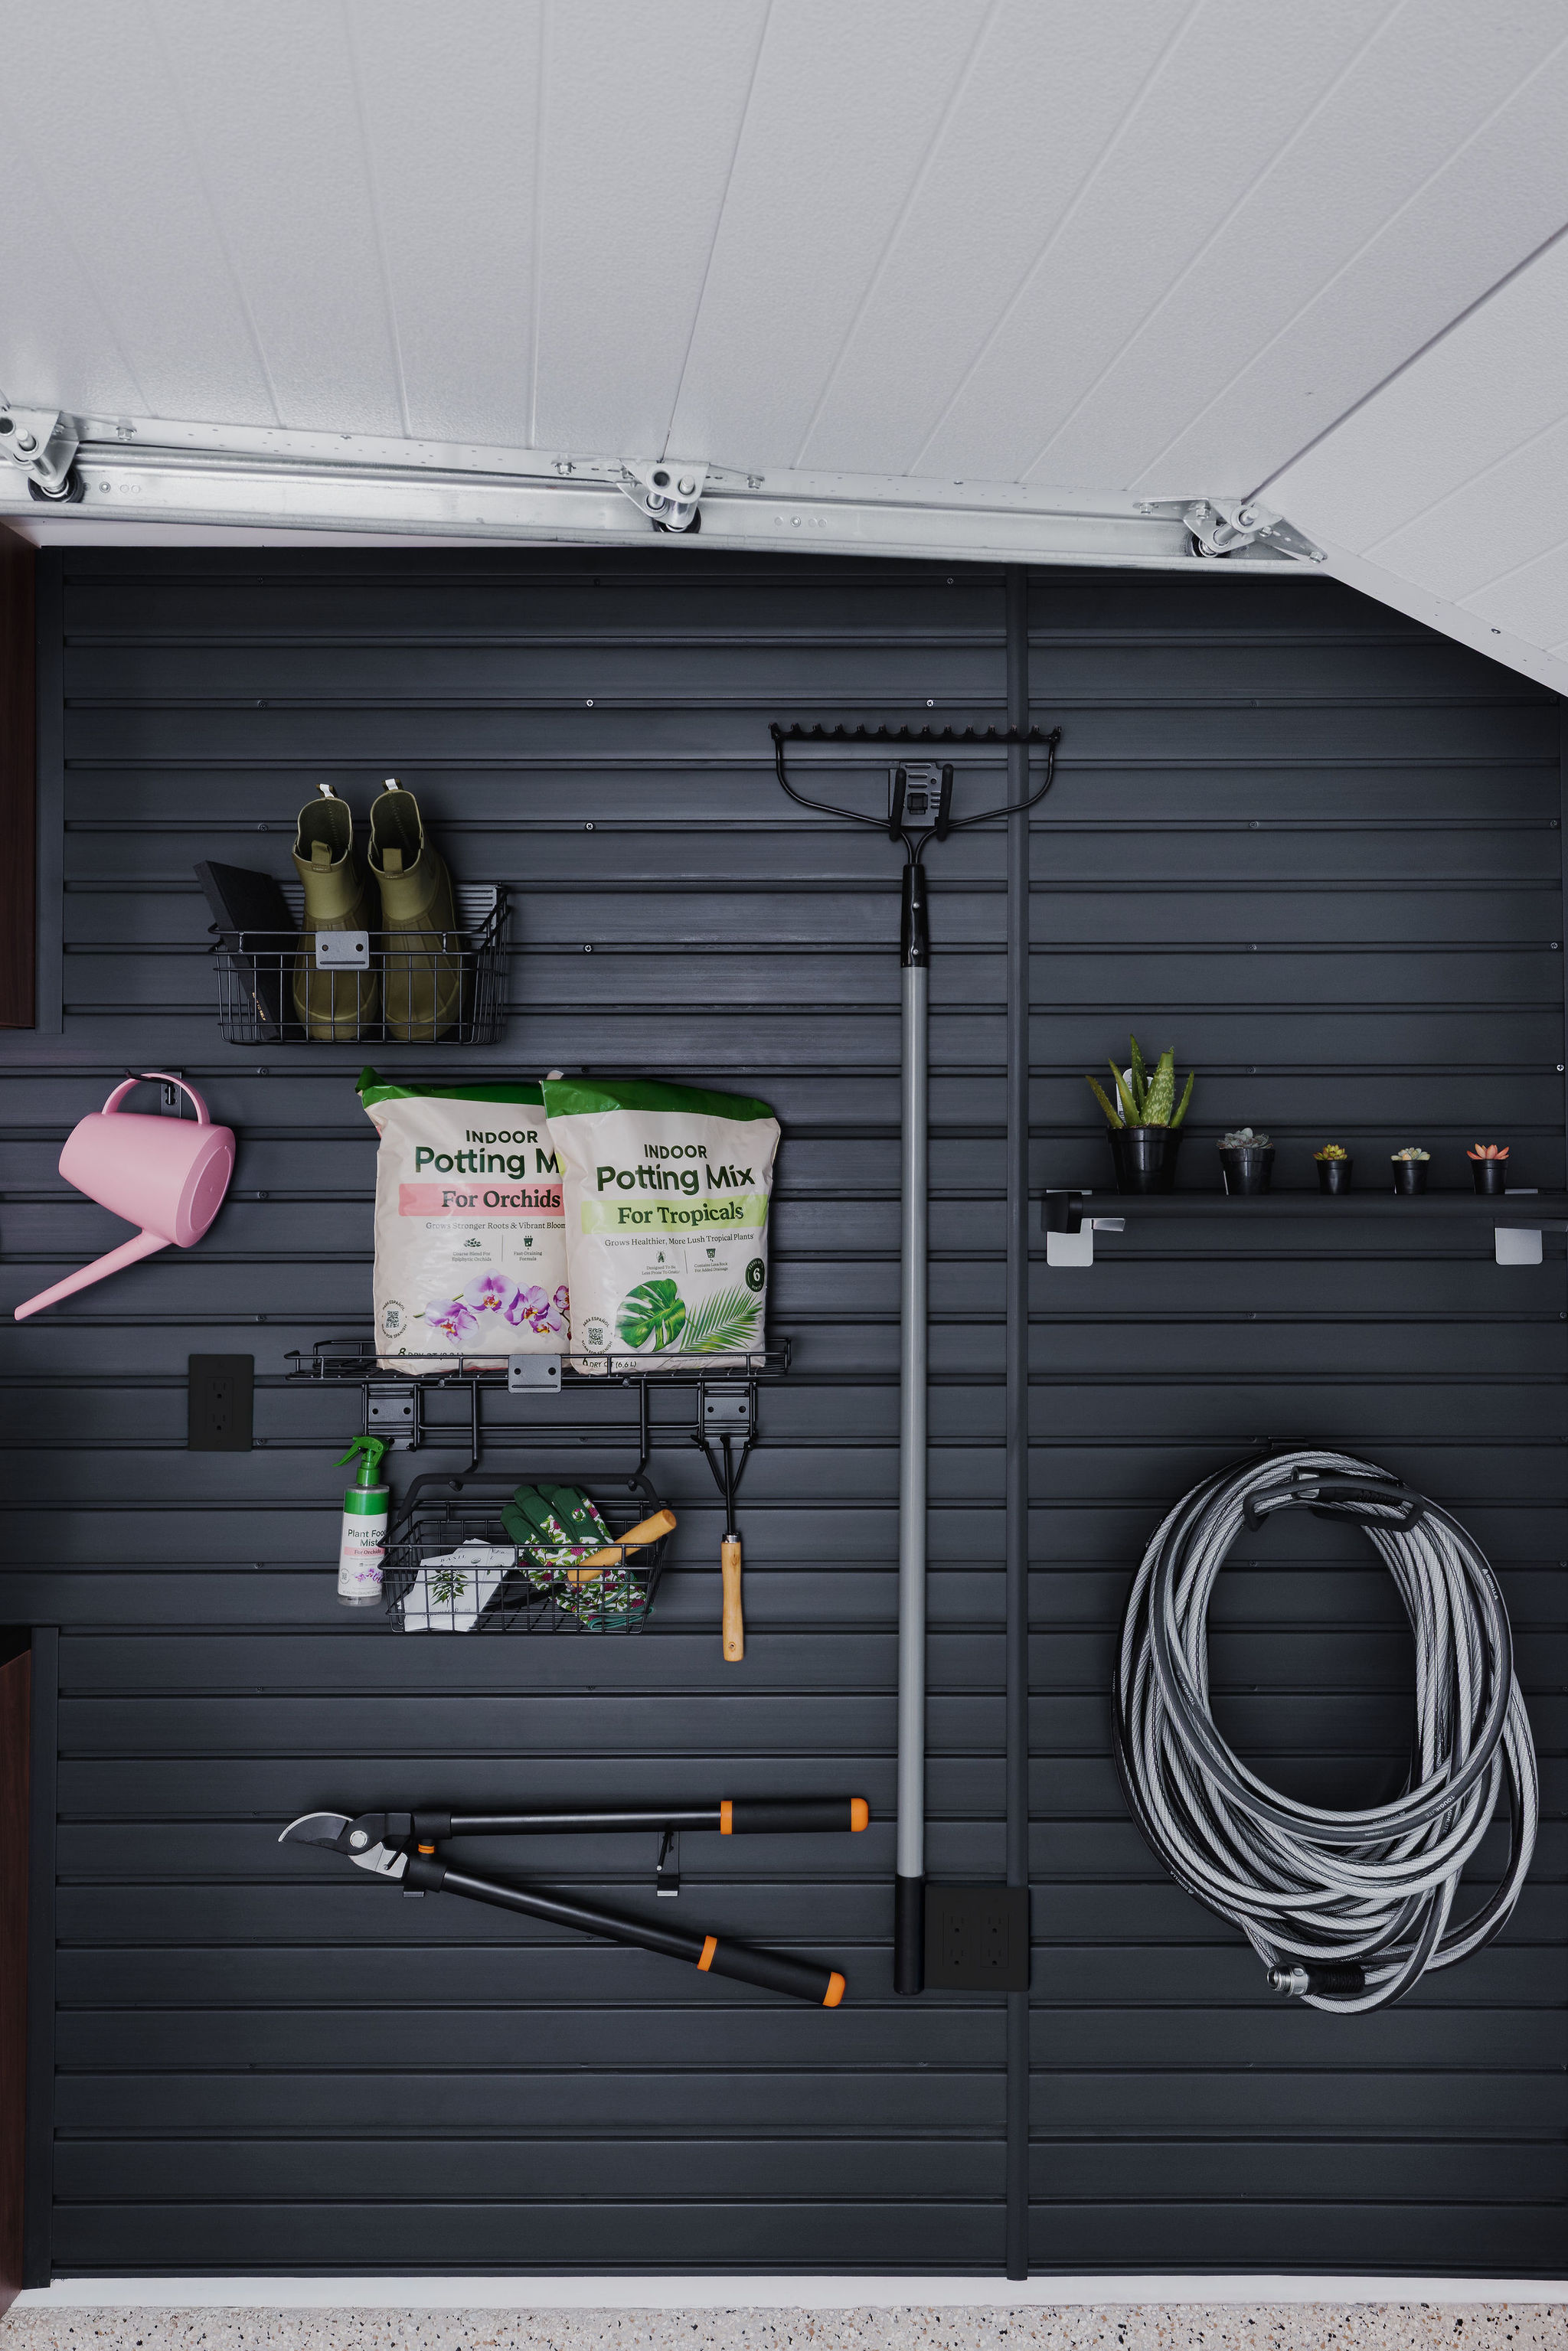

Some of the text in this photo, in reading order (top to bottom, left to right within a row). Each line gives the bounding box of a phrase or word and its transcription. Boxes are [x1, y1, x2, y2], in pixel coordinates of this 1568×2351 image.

[466, 1129, 538, 1144] INDOOR
[644, 1144, 707, 1159] INDOOR
[415, 1146, 525, 1180] Potting
[596, 1164, 756, 1196] Potting Mix
[442, 1189, 560, 1208] For Orchids
[617, 1201, 744, 1226] For Tropicals
[452, 1222, 486, 1231] Stronger
[632, 1237, 668, 1246] Healthier,
[706, 1233, 733, 1242] Tropical
[753, 1268, 761, 1282] 6
[348, 1529, 369, 1537] Plant
[1486, 1574, 1498, 1600] GORILLA
[1425, 1795, 1455, 1819] TOUGHLITE
